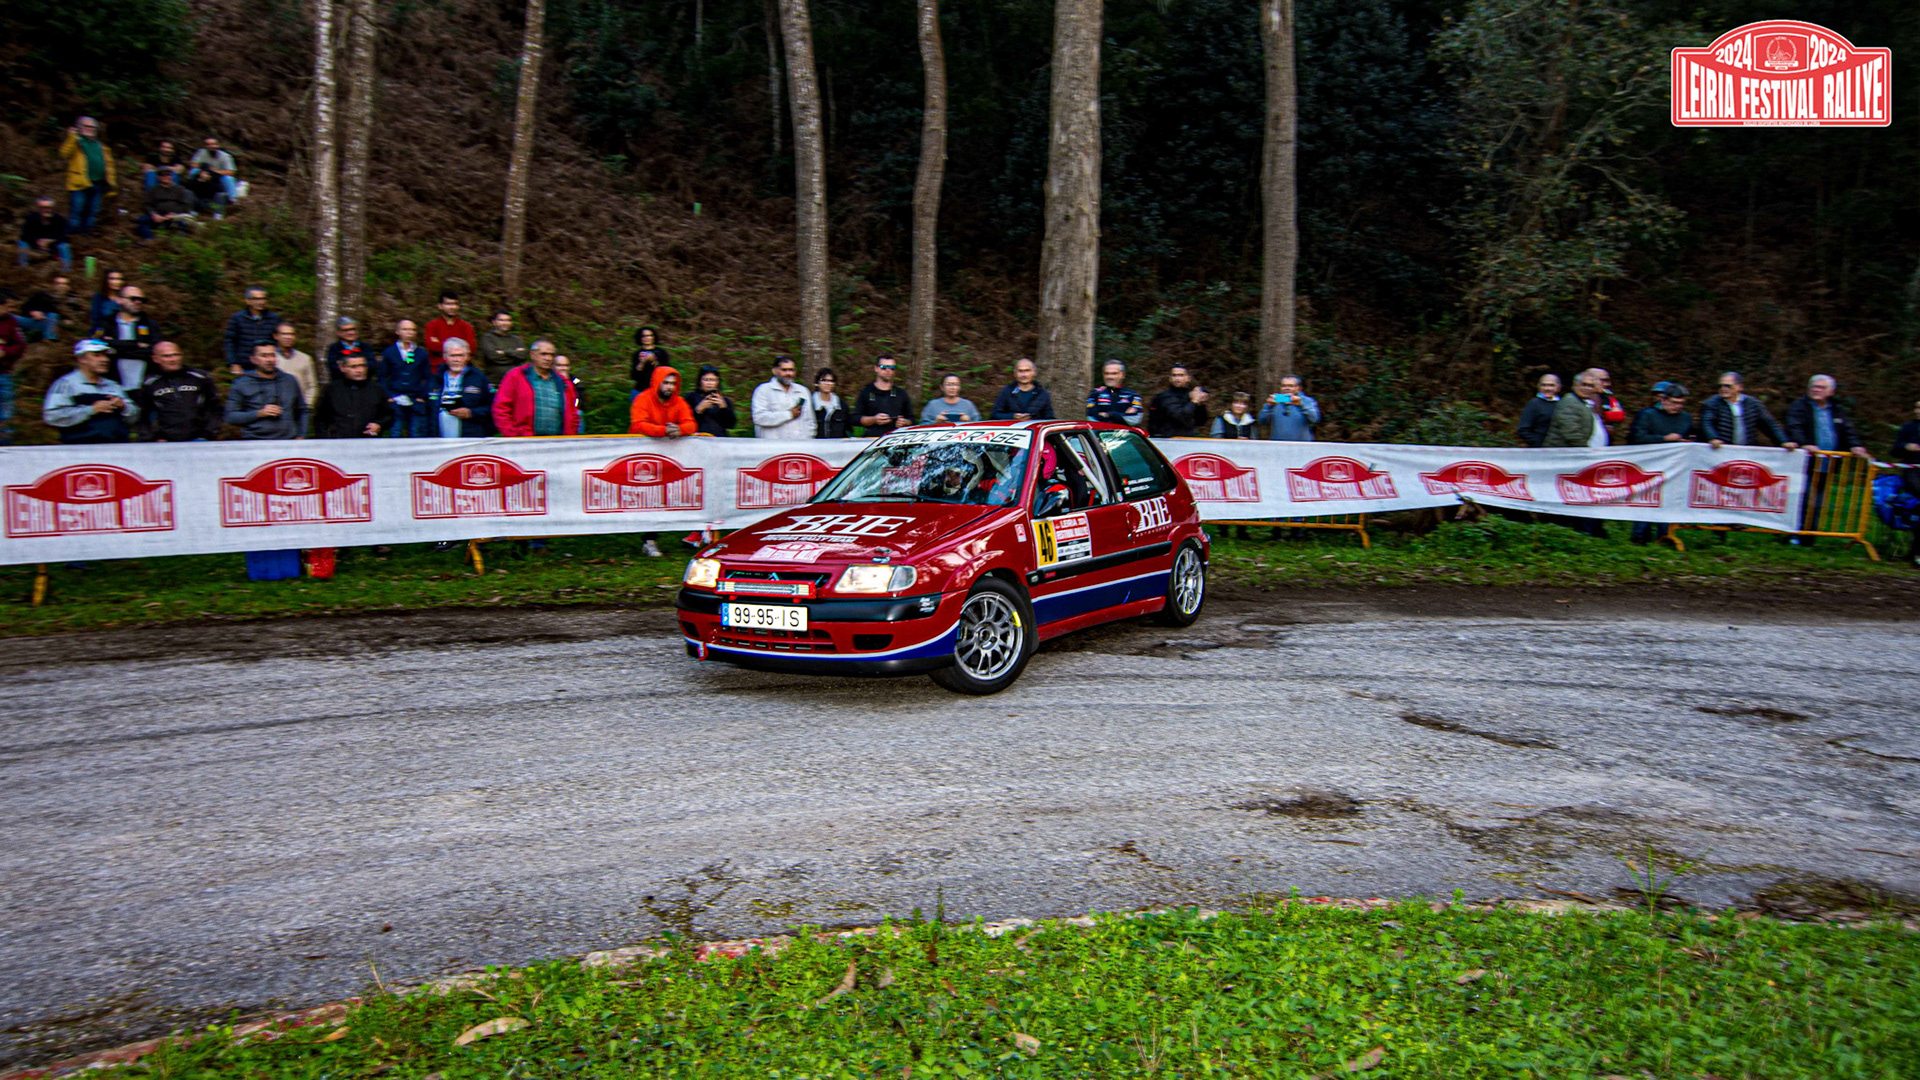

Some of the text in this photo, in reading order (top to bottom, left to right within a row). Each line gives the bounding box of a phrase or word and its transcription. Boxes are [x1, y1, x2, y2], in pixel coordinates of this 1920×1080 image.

[122, 485, 172, 527] RALLYE
[224, 479, 369, 522] LEIRIA FESTIVAL RALLYE
[454, 488, 505, 513] FESTIVAL
[506, 475, 545, 511] RALLYE
[752, 515, 916, 537] BHE
[1130, 496, 1172, 533] BHE
[1038, 522, 1054, 562] 46
